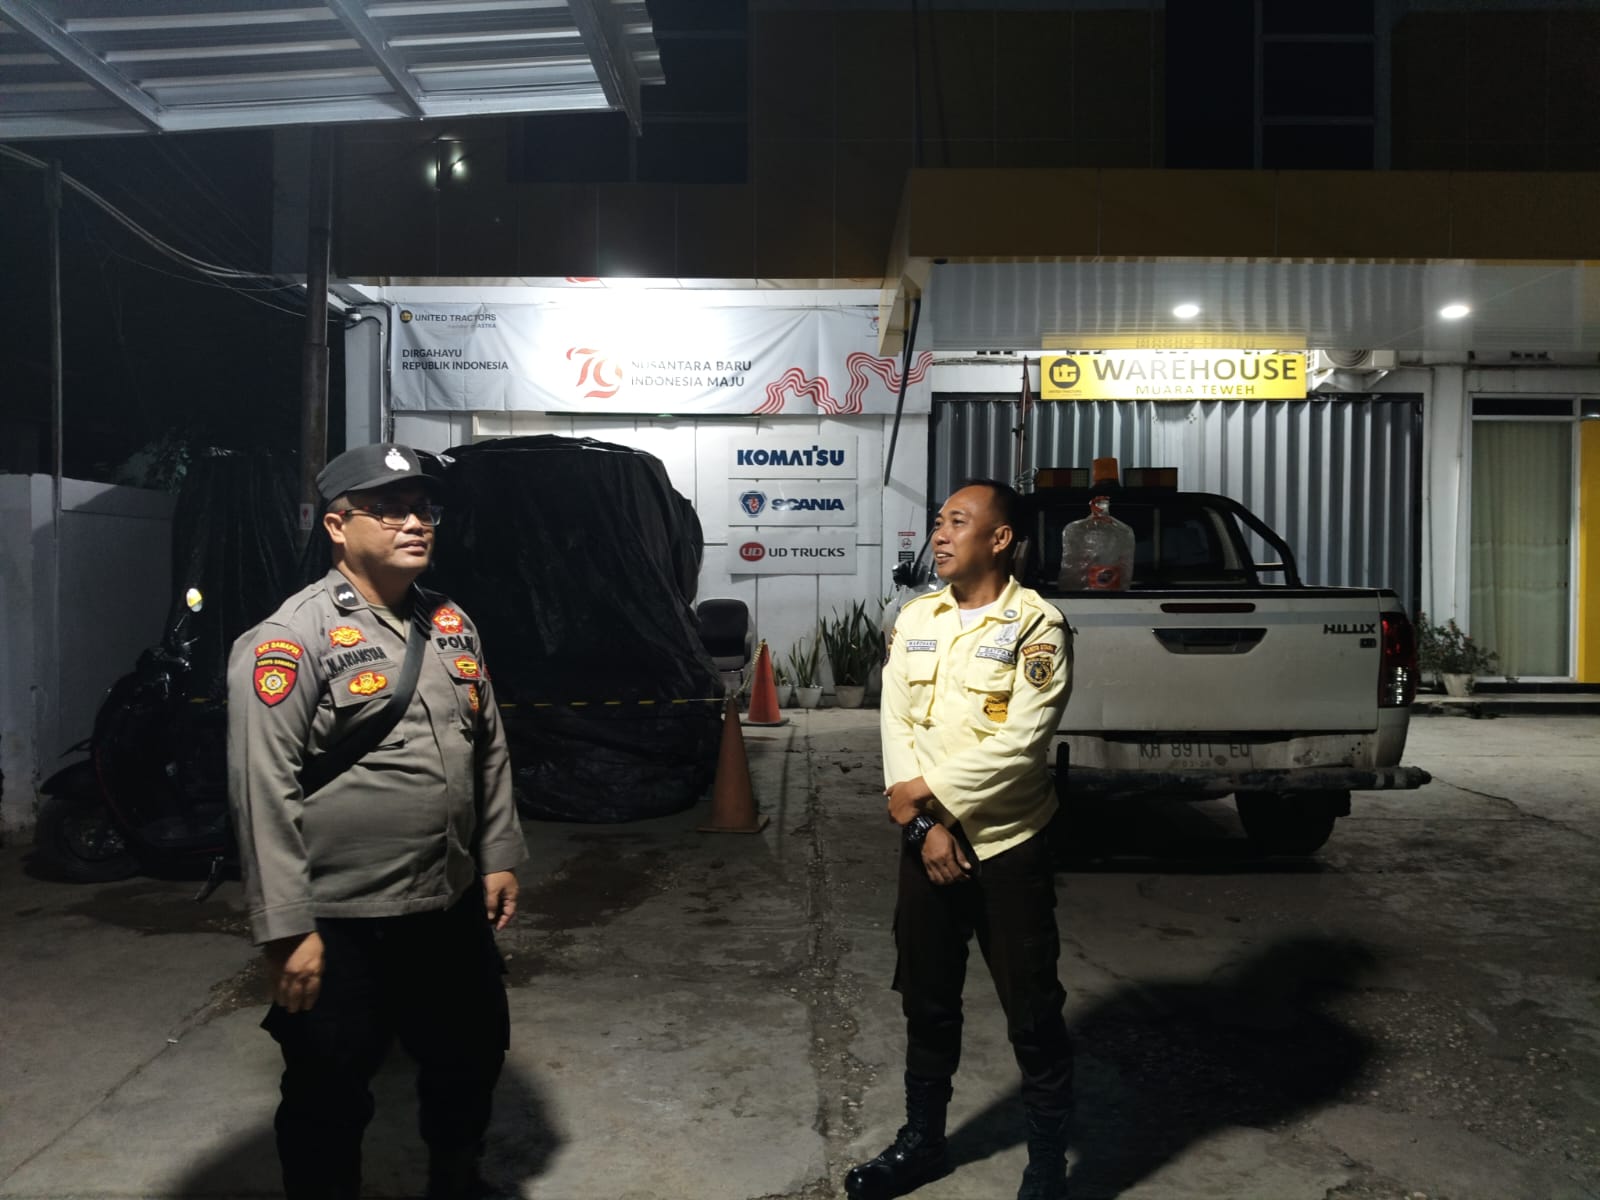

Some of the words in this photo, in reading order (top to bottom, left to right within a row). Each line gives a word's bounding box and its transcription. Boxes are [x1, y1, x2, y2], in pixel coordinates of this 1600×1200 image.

[415, 314, 447, 322] UNITED
[450, 313, 497, 322] TRACTORS
[402, 348, 462, 358] DIRGAHAYU
[402, 361, 450, 370] REPUBLIK
[452, 361, 509, 370] INDONESIA
[631, 360, 712, 371] NUSANTARA
[716, 360, 752, 371] BARU
[1093, 359, 1298, 380] WAREHOUSE
[631, 376, 703, 387] INDONESIA
[707, 376, 745, 387] MAJU
[1136, 385, 1194, 395] MUARA
[1202, 385, 1255, 395] TEWEH
[737, 445, 845, 466] KOMATSU
[771, 498, 845, 511] SCANIA
[768, 547, 787, 557] UD
[793, 547, 845, 557] TRUCKS
[1323, 623, 1376, 634] HILUX
[1171, 742, 1213, 758] 8911
